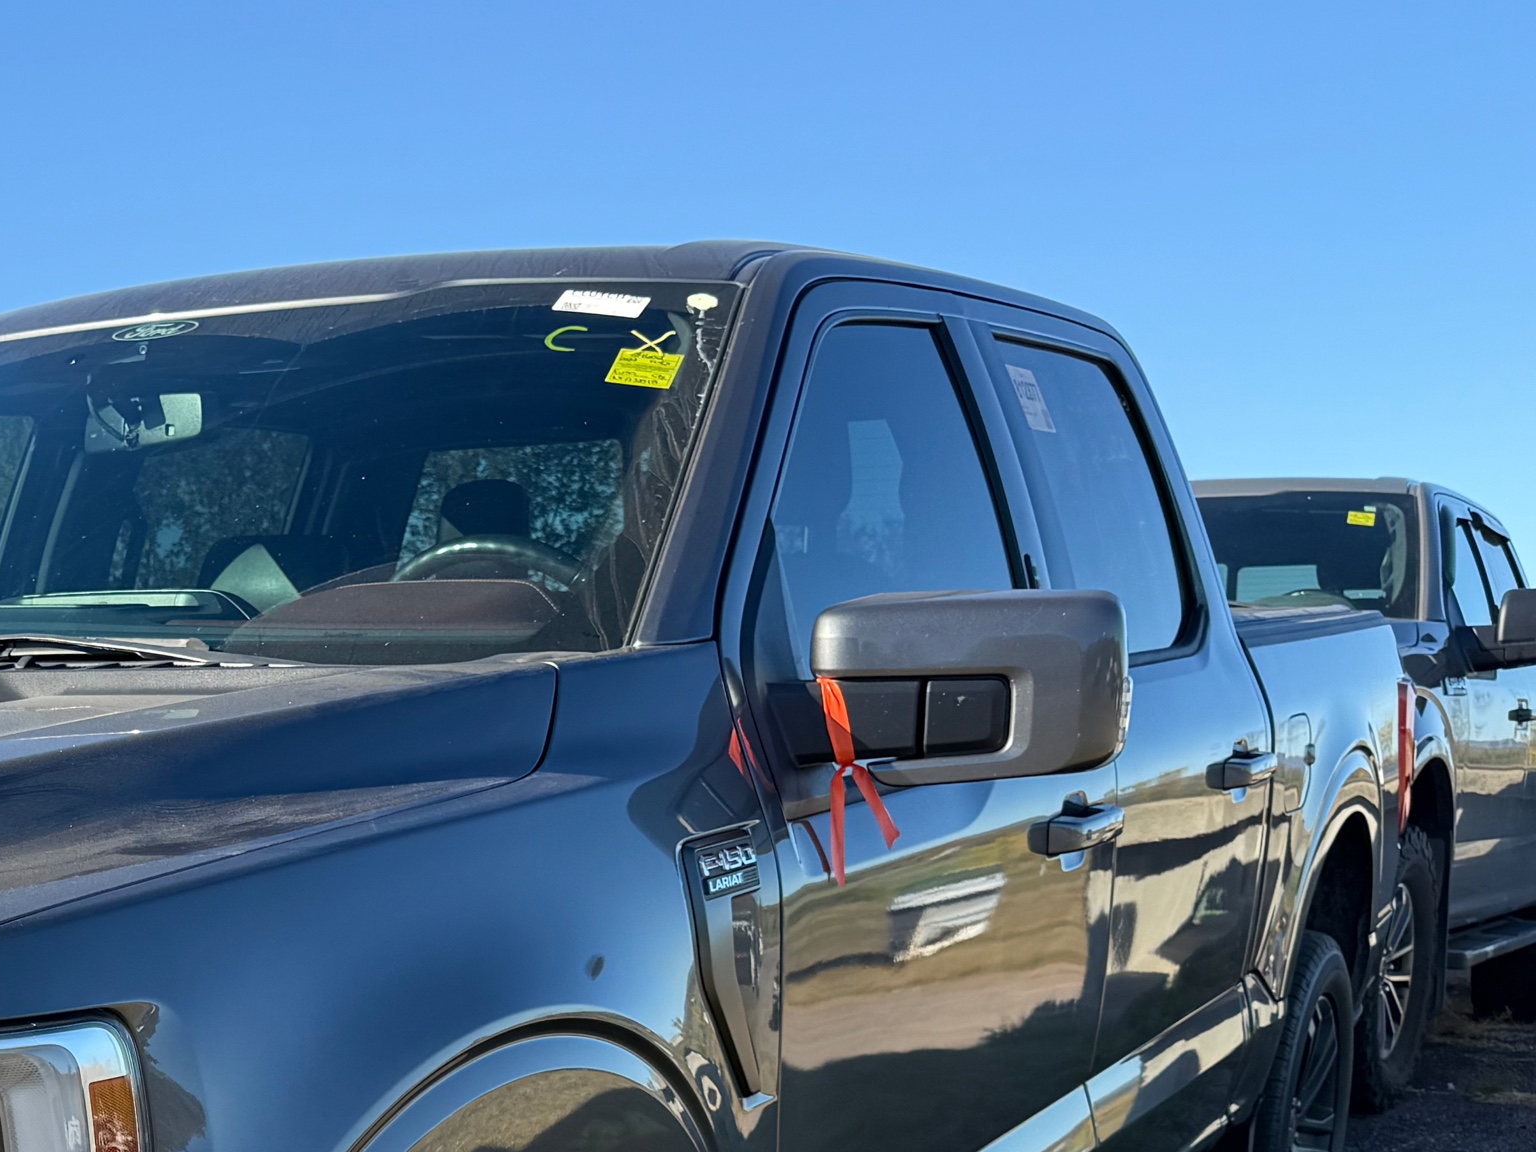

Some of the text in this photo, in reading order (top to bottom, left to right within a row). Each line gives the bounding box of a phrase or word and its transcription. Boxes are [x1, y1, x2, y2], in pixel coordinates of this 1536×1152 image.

[124, 322, 185, 340] Ford
[698, 845, 757, 877] F-150
[708, 872, 744, 893] LARIAT
